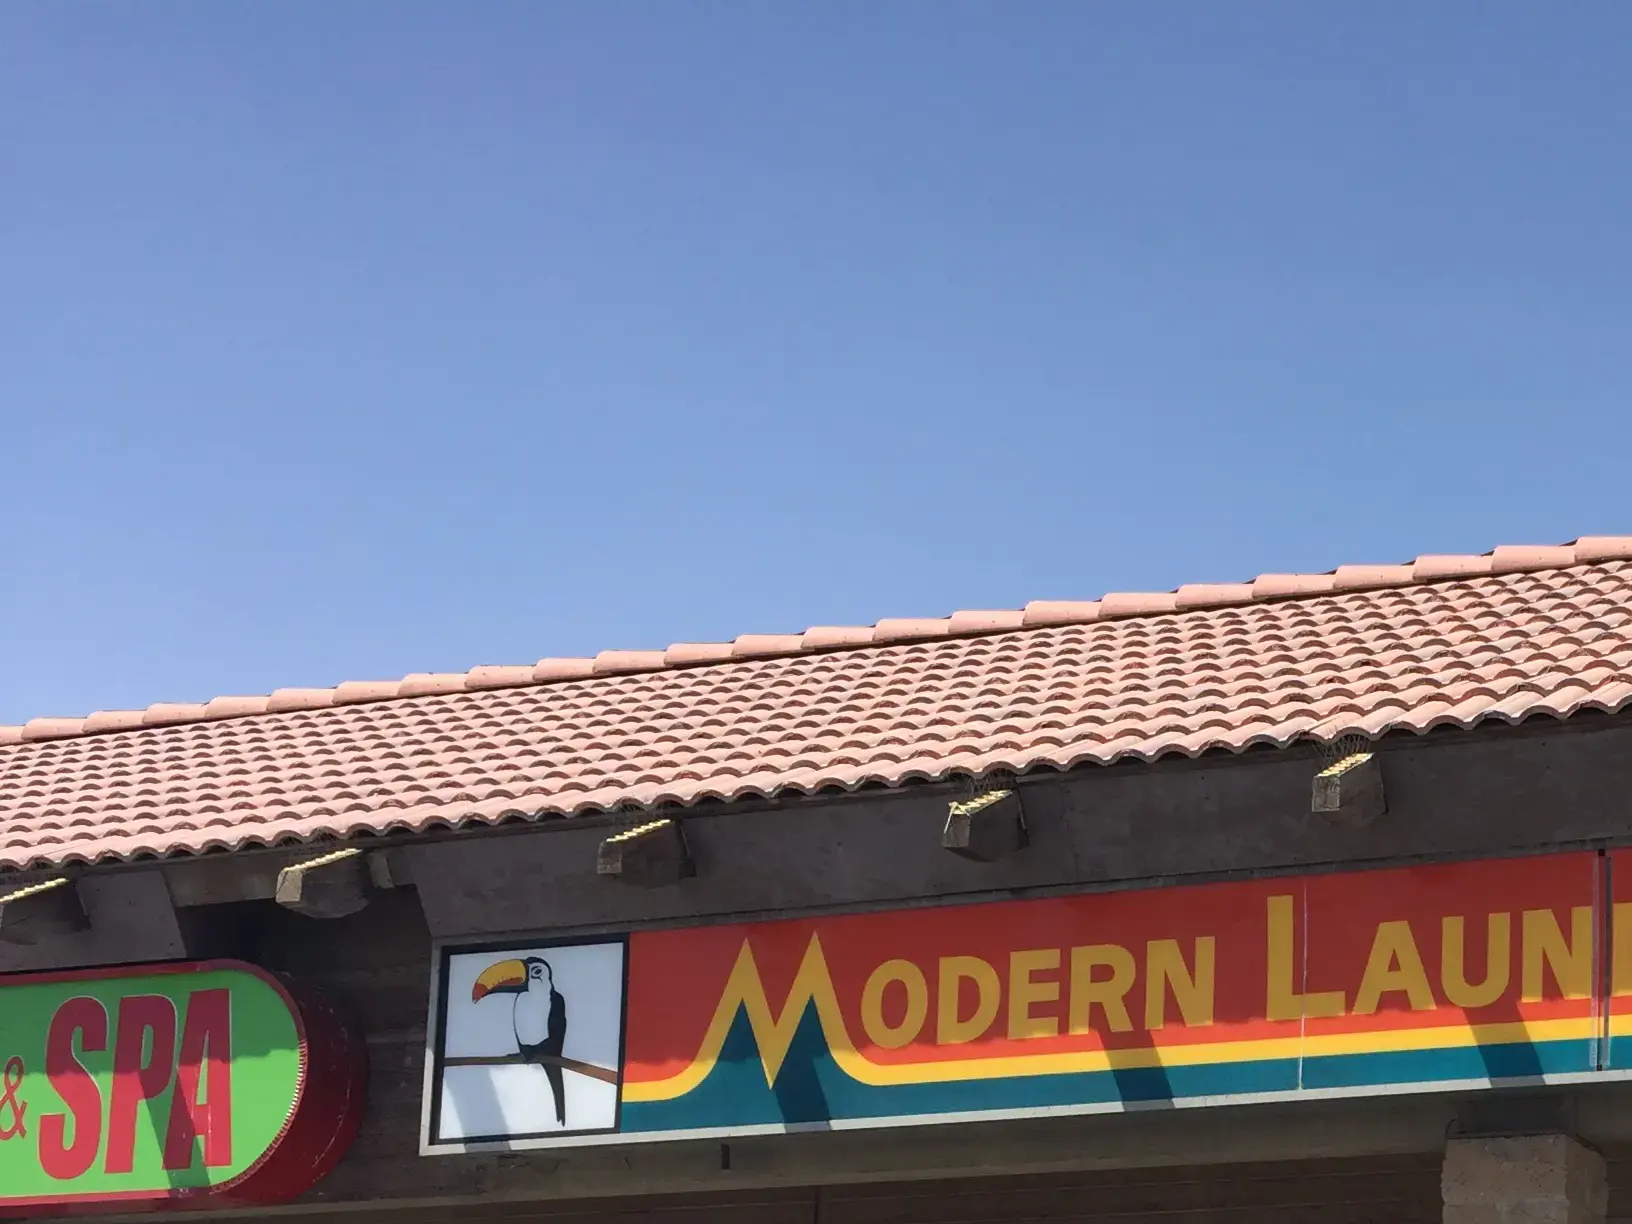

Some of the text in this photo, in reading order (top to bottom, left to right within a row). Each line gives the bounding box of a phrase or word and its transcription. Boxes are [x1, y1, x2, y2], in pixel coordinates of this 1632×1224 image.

[0, 987, 232, 1180] & SPA
[676, 930, 1216, 1090] MODERN
